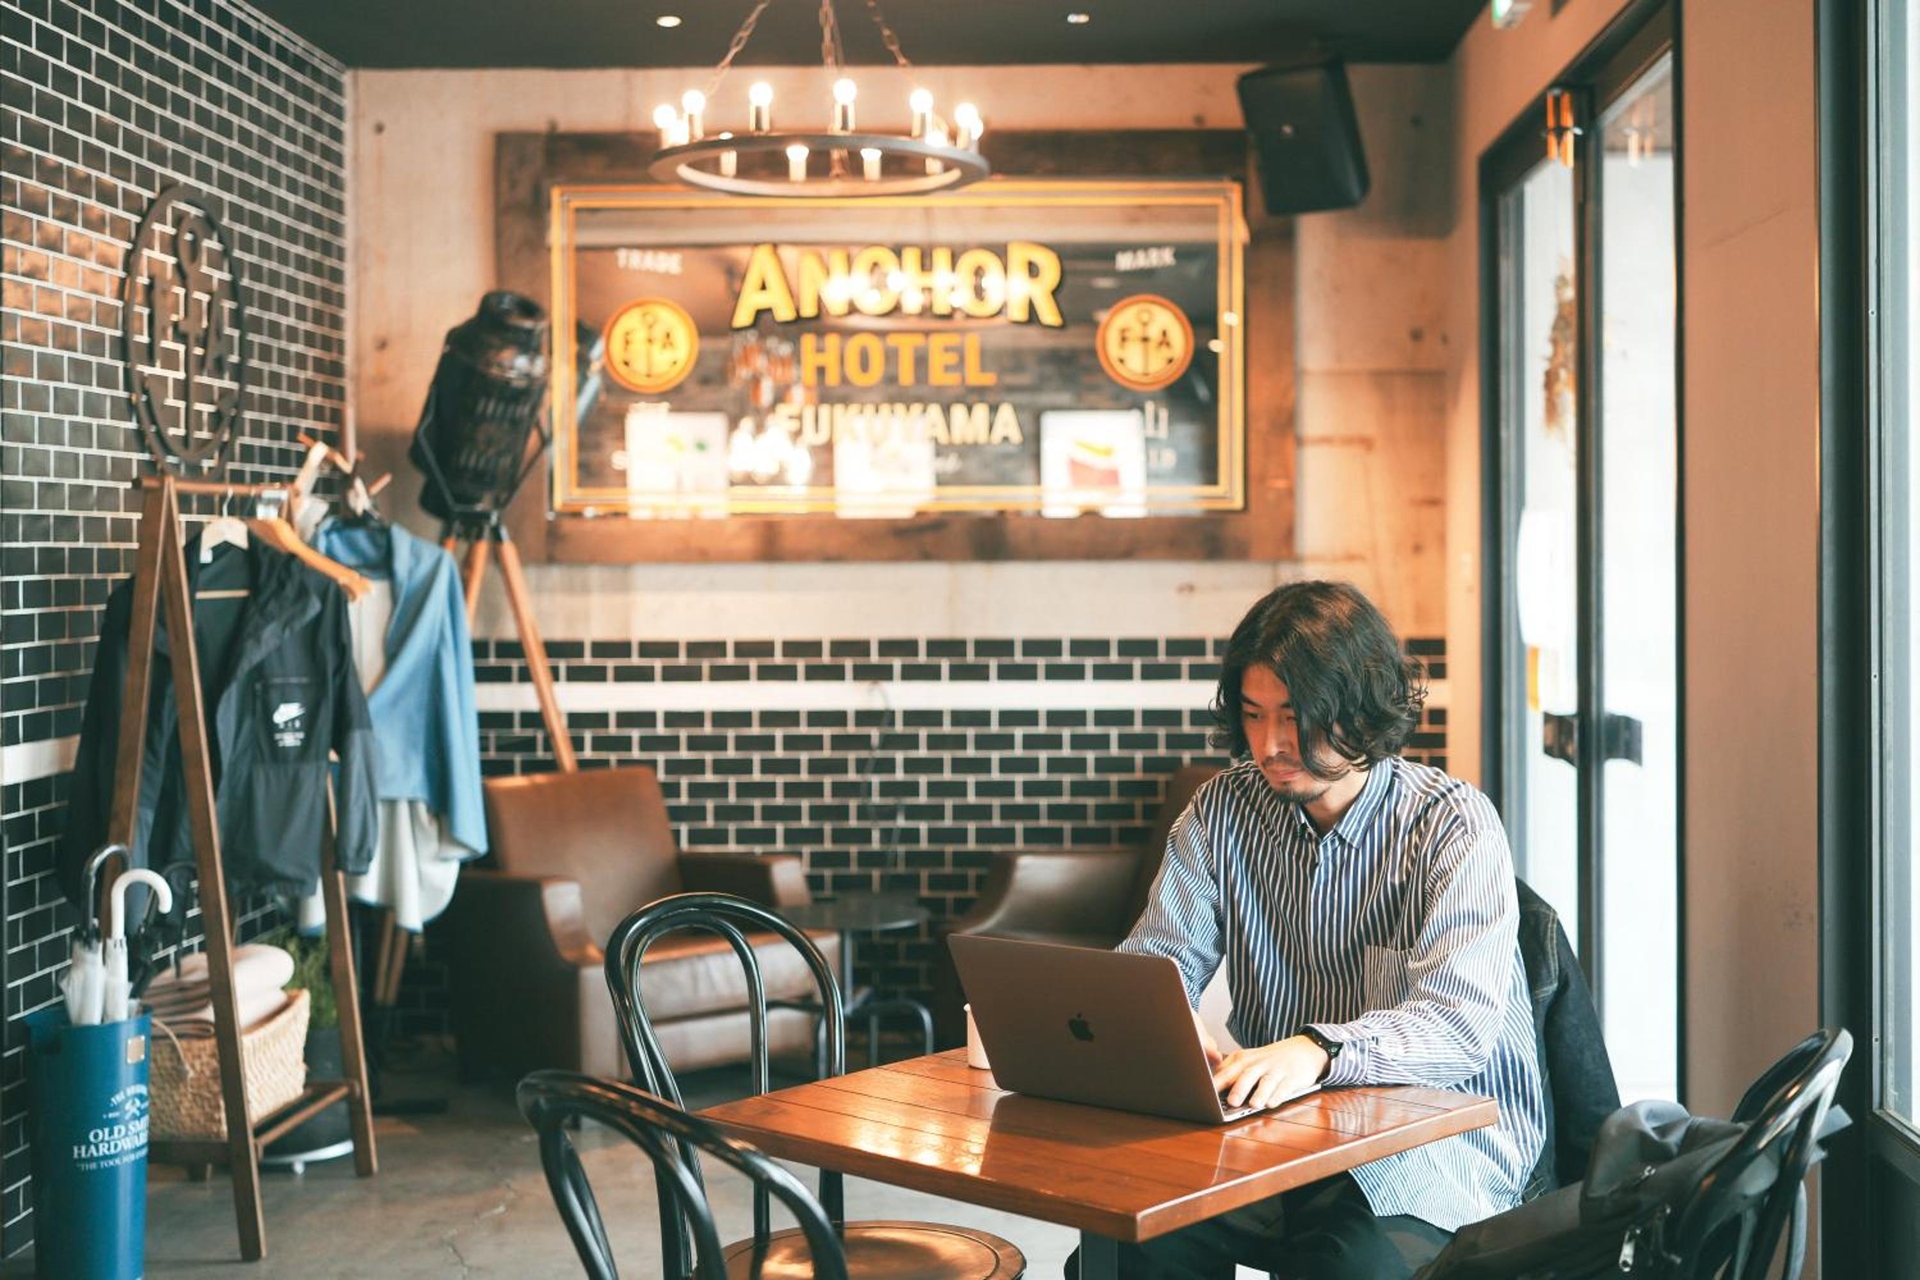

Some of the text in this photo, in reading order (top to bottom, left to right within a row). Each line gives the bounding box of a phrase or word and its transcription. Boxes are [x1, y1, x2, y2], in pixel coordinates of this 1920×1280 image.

[615, 247, 682, 275] TRADE
[1115, 246, 1176, 271] MARK
[732, 240, 1063, 327] ANCHOR
[799, 332, 998, 387] HOTEL
[775, 402, 1023, 446] FUKUYAMA
[88, 1124, 126, 1143] OLD
